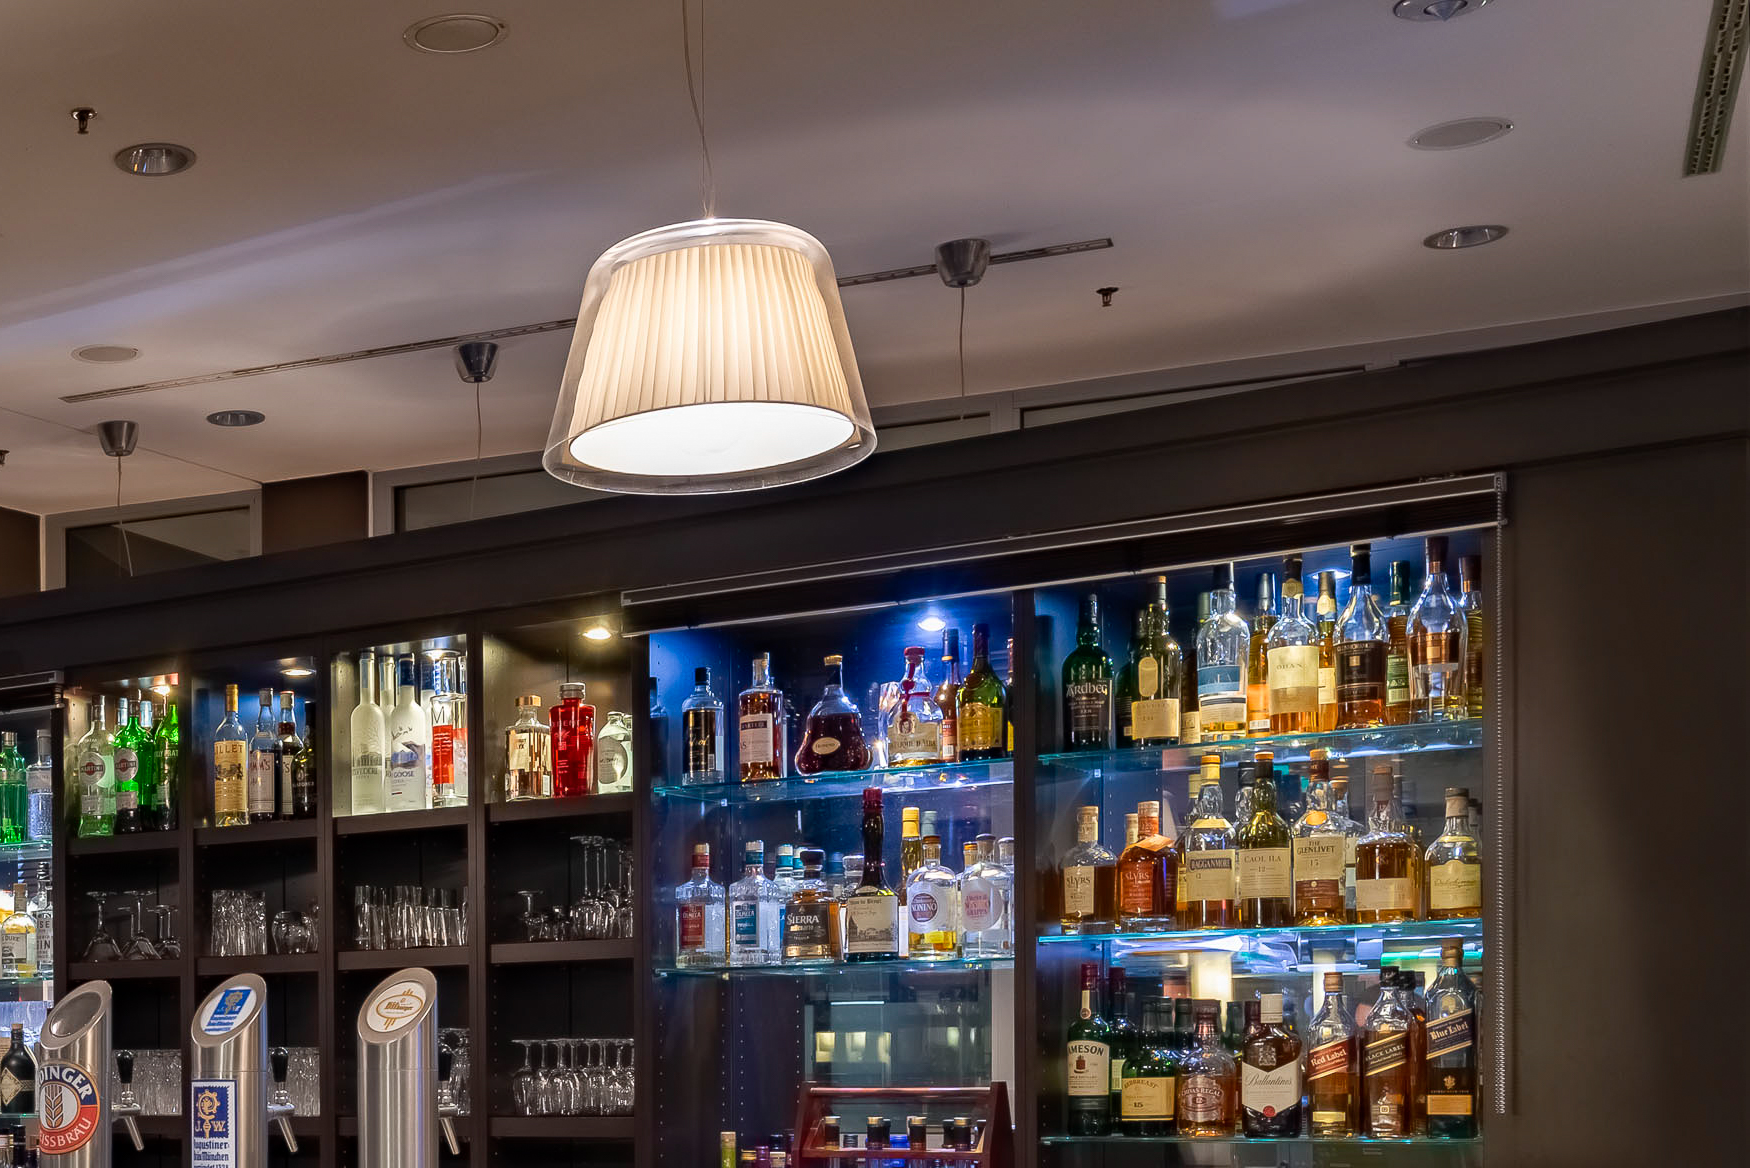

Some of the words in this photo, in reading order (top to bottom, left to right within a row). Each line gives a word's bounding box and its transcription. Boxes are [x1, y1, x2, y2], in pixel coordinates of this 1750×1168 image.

[393, 770, 415, 778] GOOSE
[1297, 845, 1336, 855] GLENLIVET
[1244, 855, 1266, 863] CAOL
[1309, 859, 1320, 867] 15
[1066, 875, 1091, 889] SLYRS
[1125, 871, 1150, 884] SLYRS
[786, 912, 820, 926] SIERRA
[1430, 1029, 1448, 1040] Blue
[1448, 1021, 1469, 1034] Label
[1385, 1044, 1405, 1054] LABEL
[1310, 1055, 1327, 1067] Red
[1327, 1048, 1347, 1062] Label
[1247, 1073, 1293, 1086] Ballantine's
[1201, 1087, 1222, 1098] REGAL
[40, 1117, 92, 1148] ISSBRÄU
